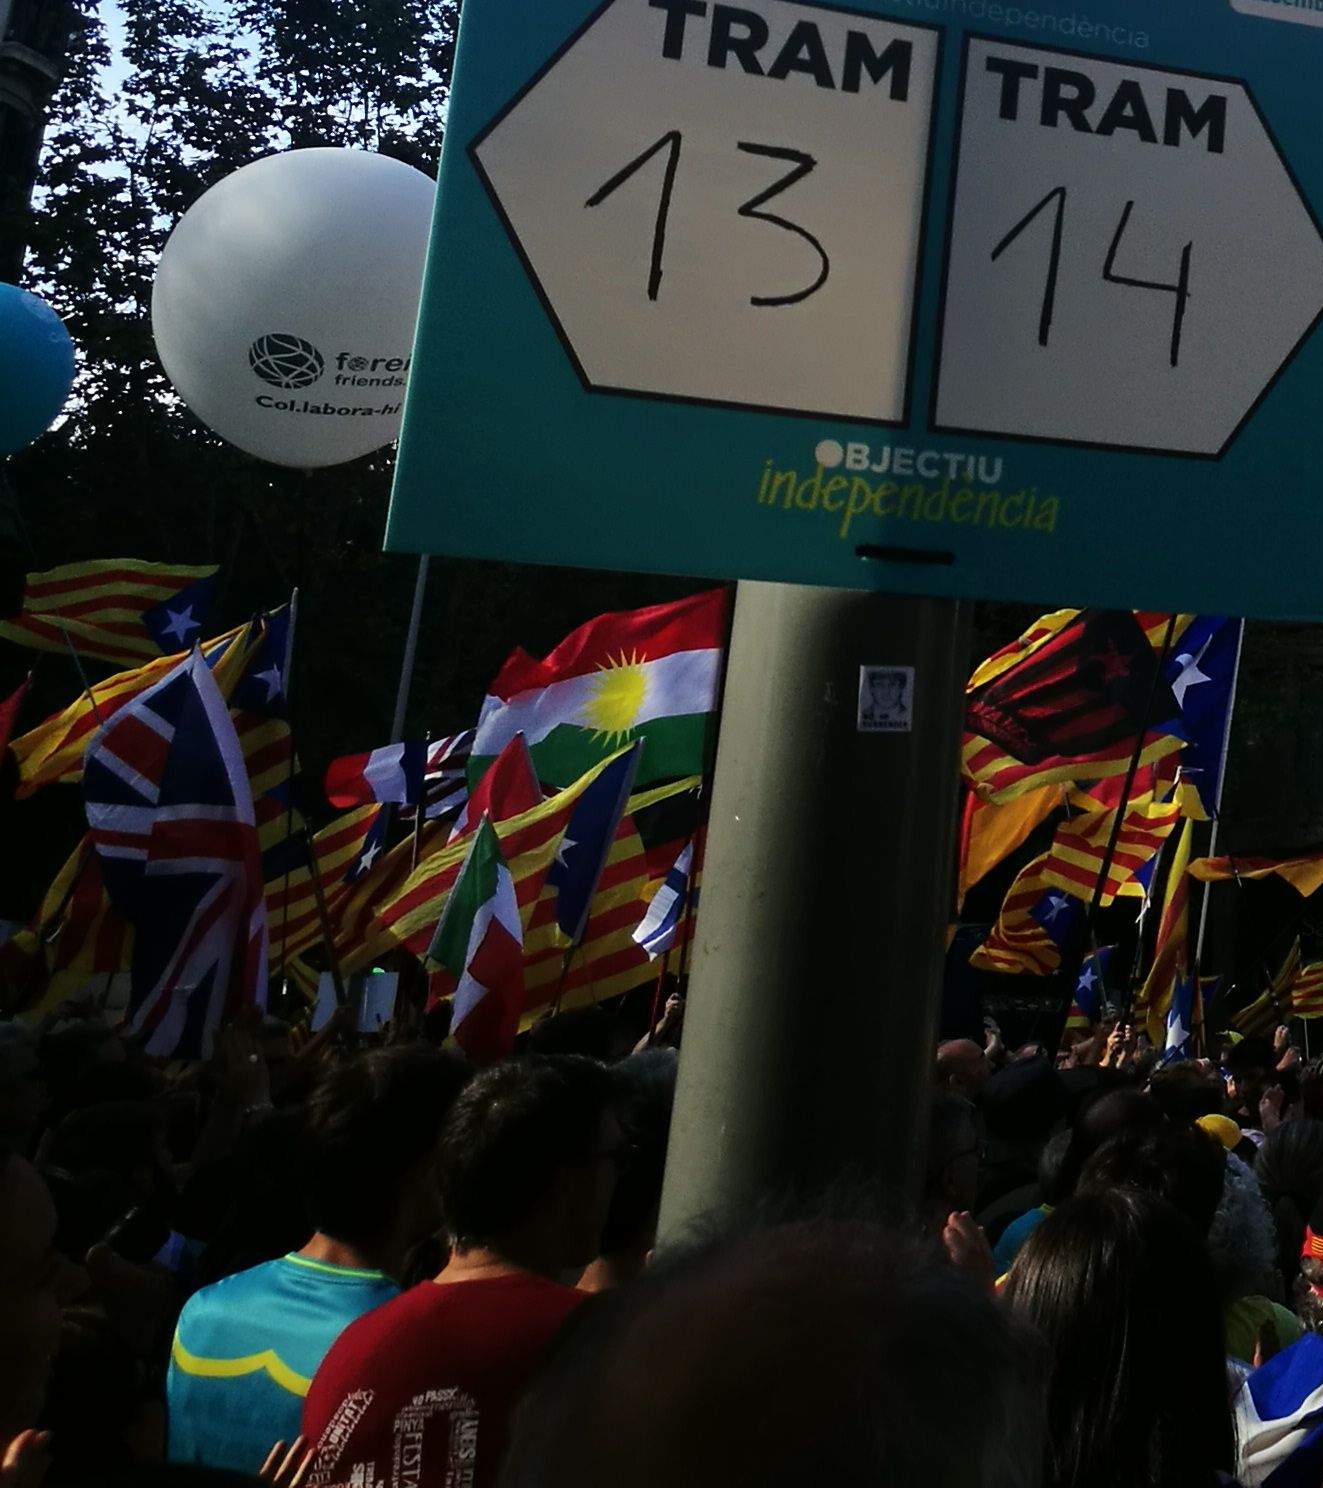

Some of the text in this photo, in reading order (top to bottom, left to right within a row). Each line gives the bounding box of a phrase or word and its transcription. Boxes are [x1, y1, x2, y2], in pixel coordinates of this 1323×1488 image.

[985, 56, 1228, 154] TRAM
[584, 130, 831, 308] 13
[990, 186, 1195, 368] 14
